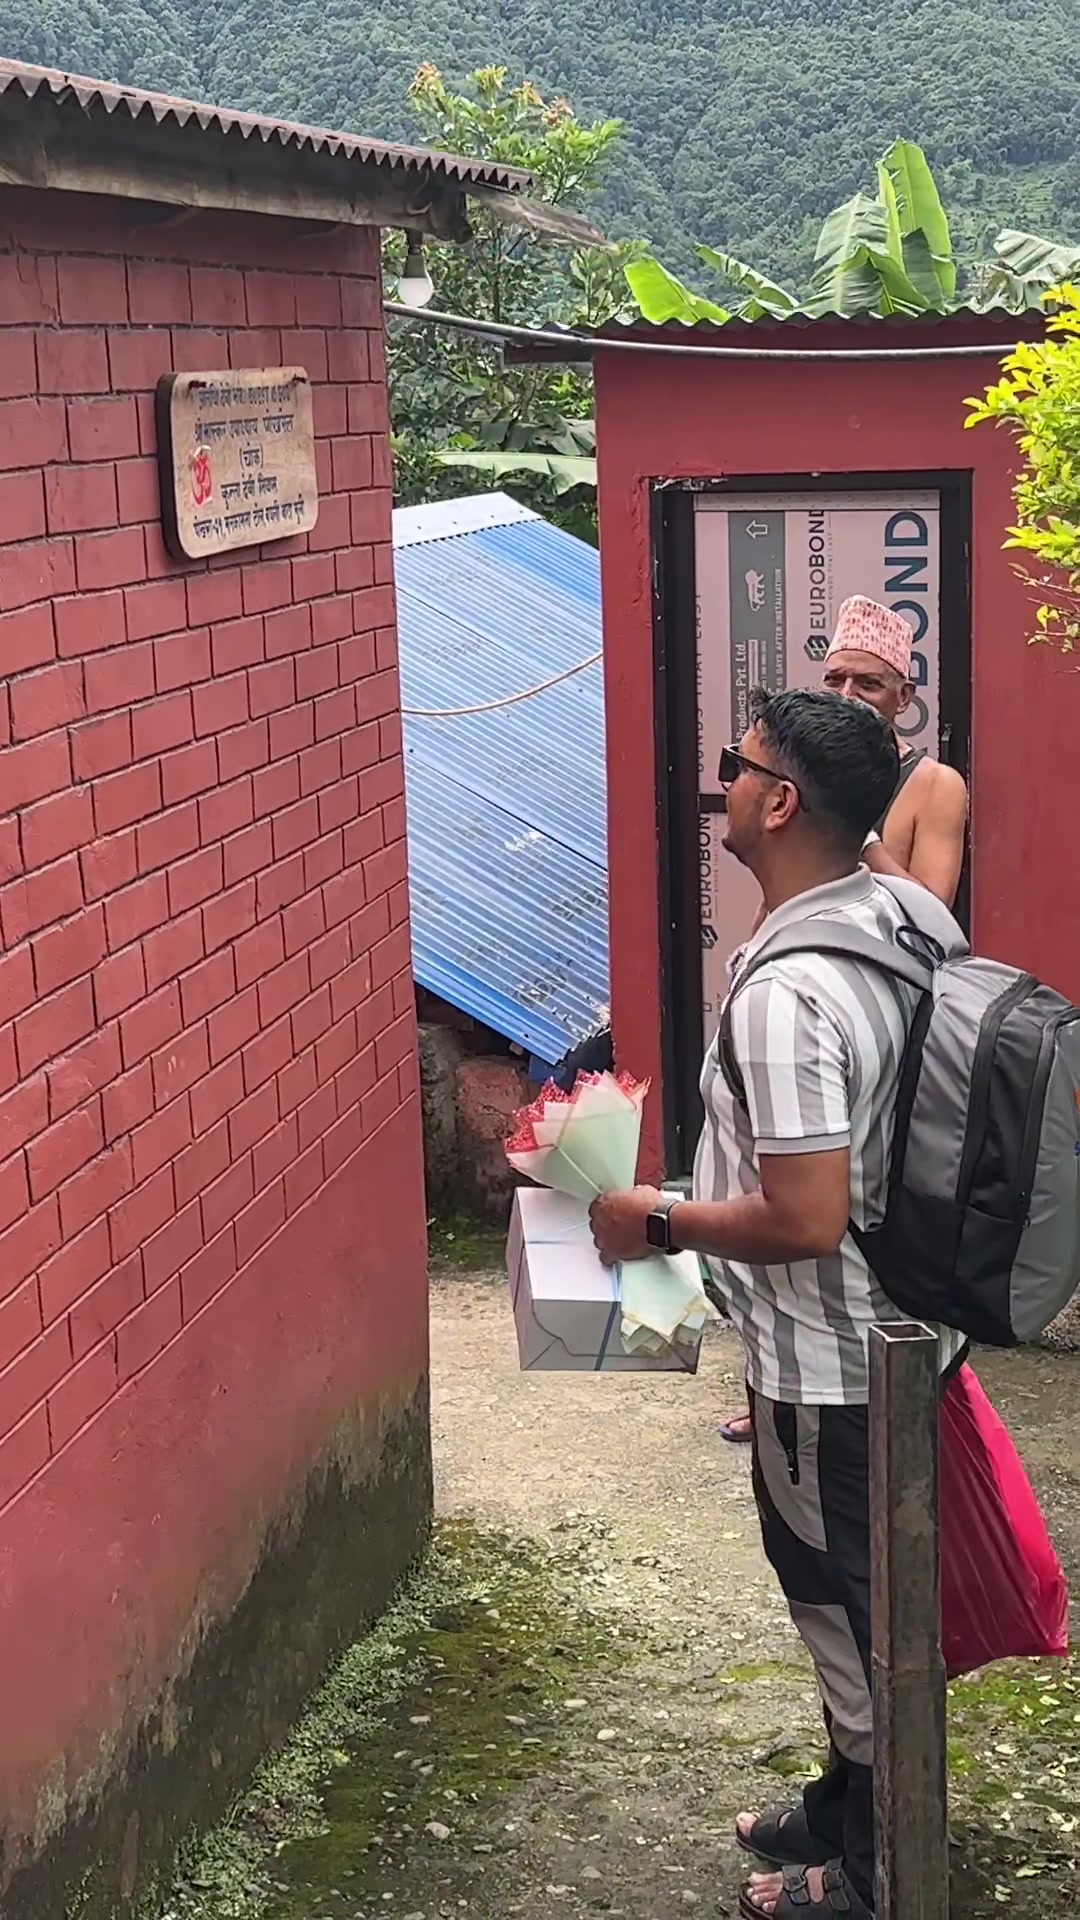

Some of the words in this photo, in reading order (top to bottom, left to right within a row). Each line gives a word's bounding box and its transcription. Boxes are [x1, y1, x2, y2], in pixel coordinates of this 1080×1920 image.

[735, 640, 746, 662] Ltd.
[775, 626, 783, 652] AFTER
[775, 653, 783, 675] DAYS
[735, 689, 747, 740] Products
